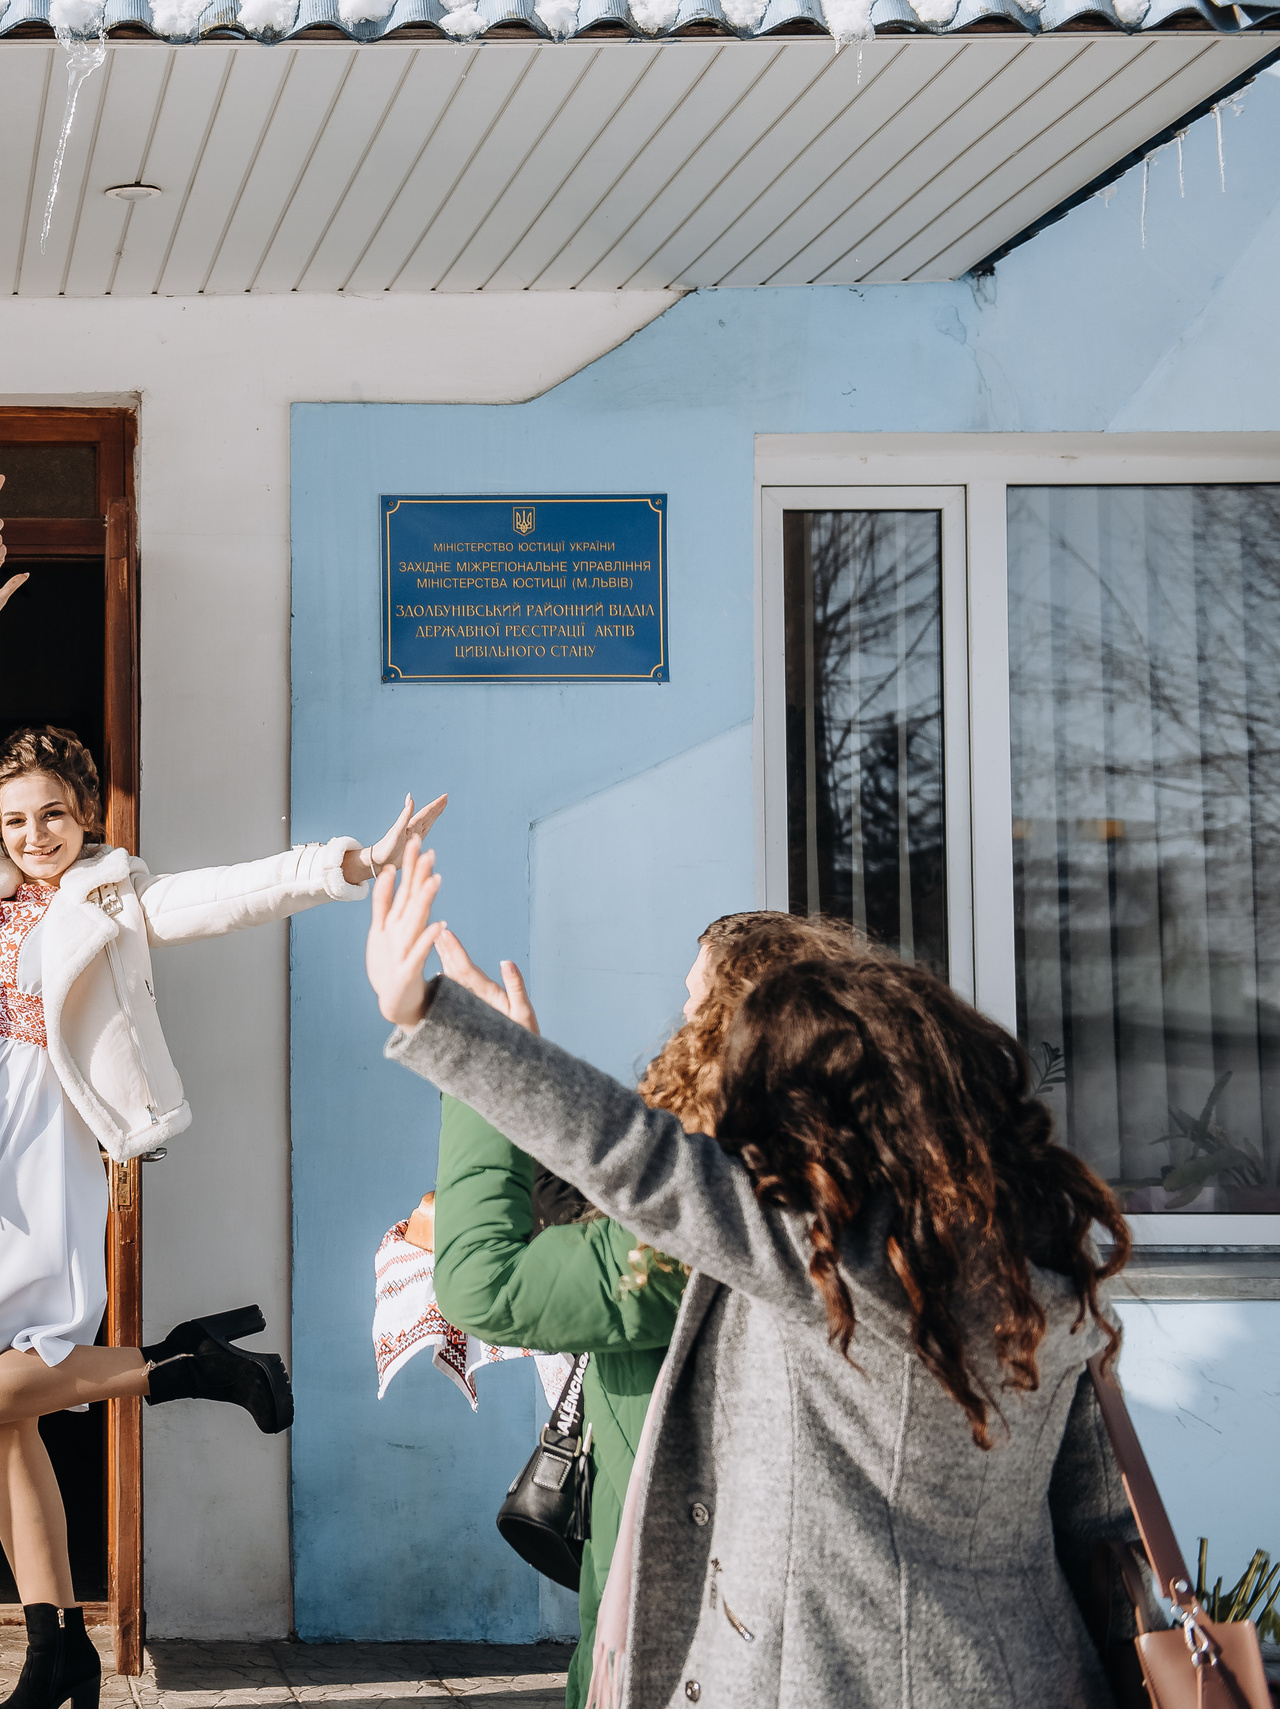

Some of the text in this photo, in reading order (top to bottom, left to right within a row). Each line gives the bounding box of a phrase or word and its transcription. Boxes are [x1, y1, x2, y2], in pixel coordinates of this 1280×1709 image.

[433, 540, 615, 554] МІНІСТЕРСТВО ЮСТИЦІЇ УКРАЇНИ
[398, 560, 651, 574] ЗАХІДНЕ МІЖРЕГІОНАЛЬНЕ УПРАВЛІННЯ
[416, 576, 634, 590] МІНІСТЕРСТВА ЮСТИЦІЇ (М.ЛЬВІВ)
[395, 601, 655, 618] ЗДОЛБУНІВСЬКИЙ РАЙОННИЙ ВІДДІЛ
[415, 621, 635, 639] ДЕРЖАВНОЇ РЕЄСТРАЦІЇ АКТІВ
[454, 644, 597, 659] ЦИВІЛЬНОГО СТАНУ
[557, 1351, 589, 1436] ALENCIAG
